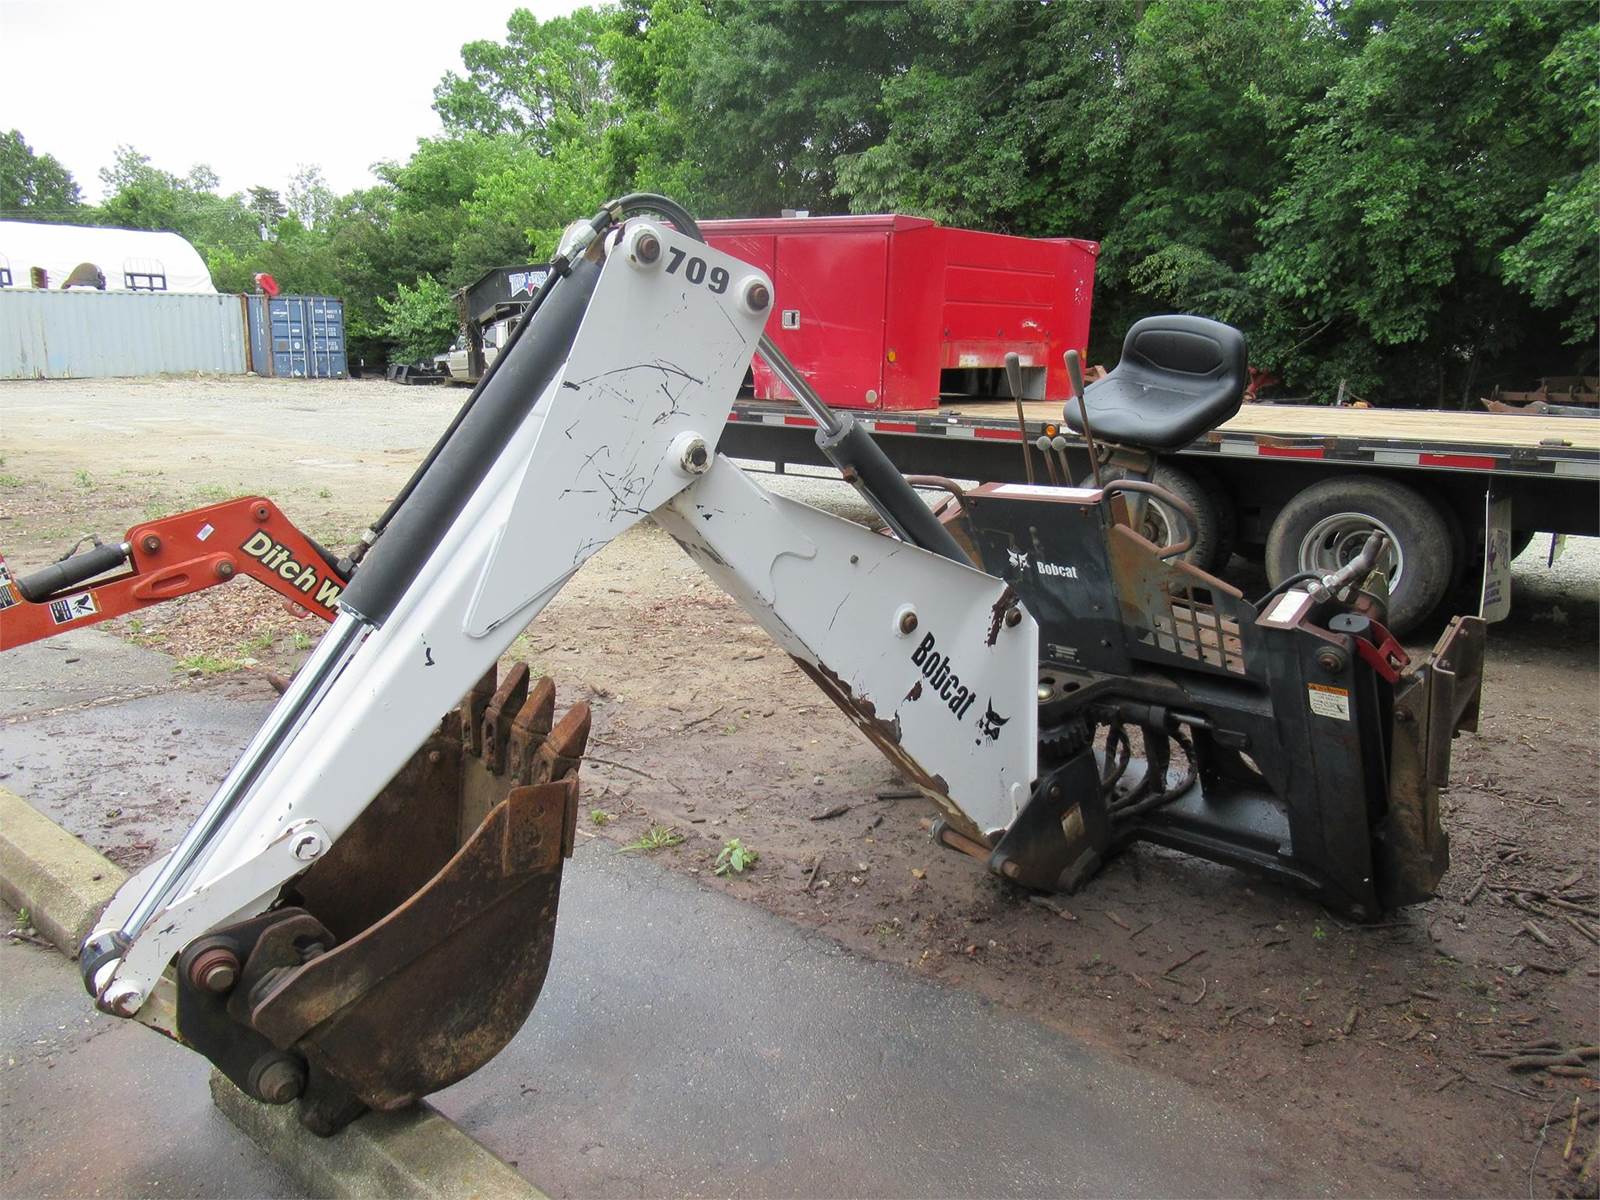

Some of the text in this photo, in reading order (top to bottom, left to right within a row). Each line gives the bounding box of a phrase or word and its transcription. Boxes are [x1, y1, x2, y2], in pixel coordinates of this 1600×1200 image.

[665, 246, 730, 294] 709
[241, 530, 317, 592] Ditch
[1036, 561, 1079, 580] Bobcat
[910, 631, 976, 720] Bobcat
